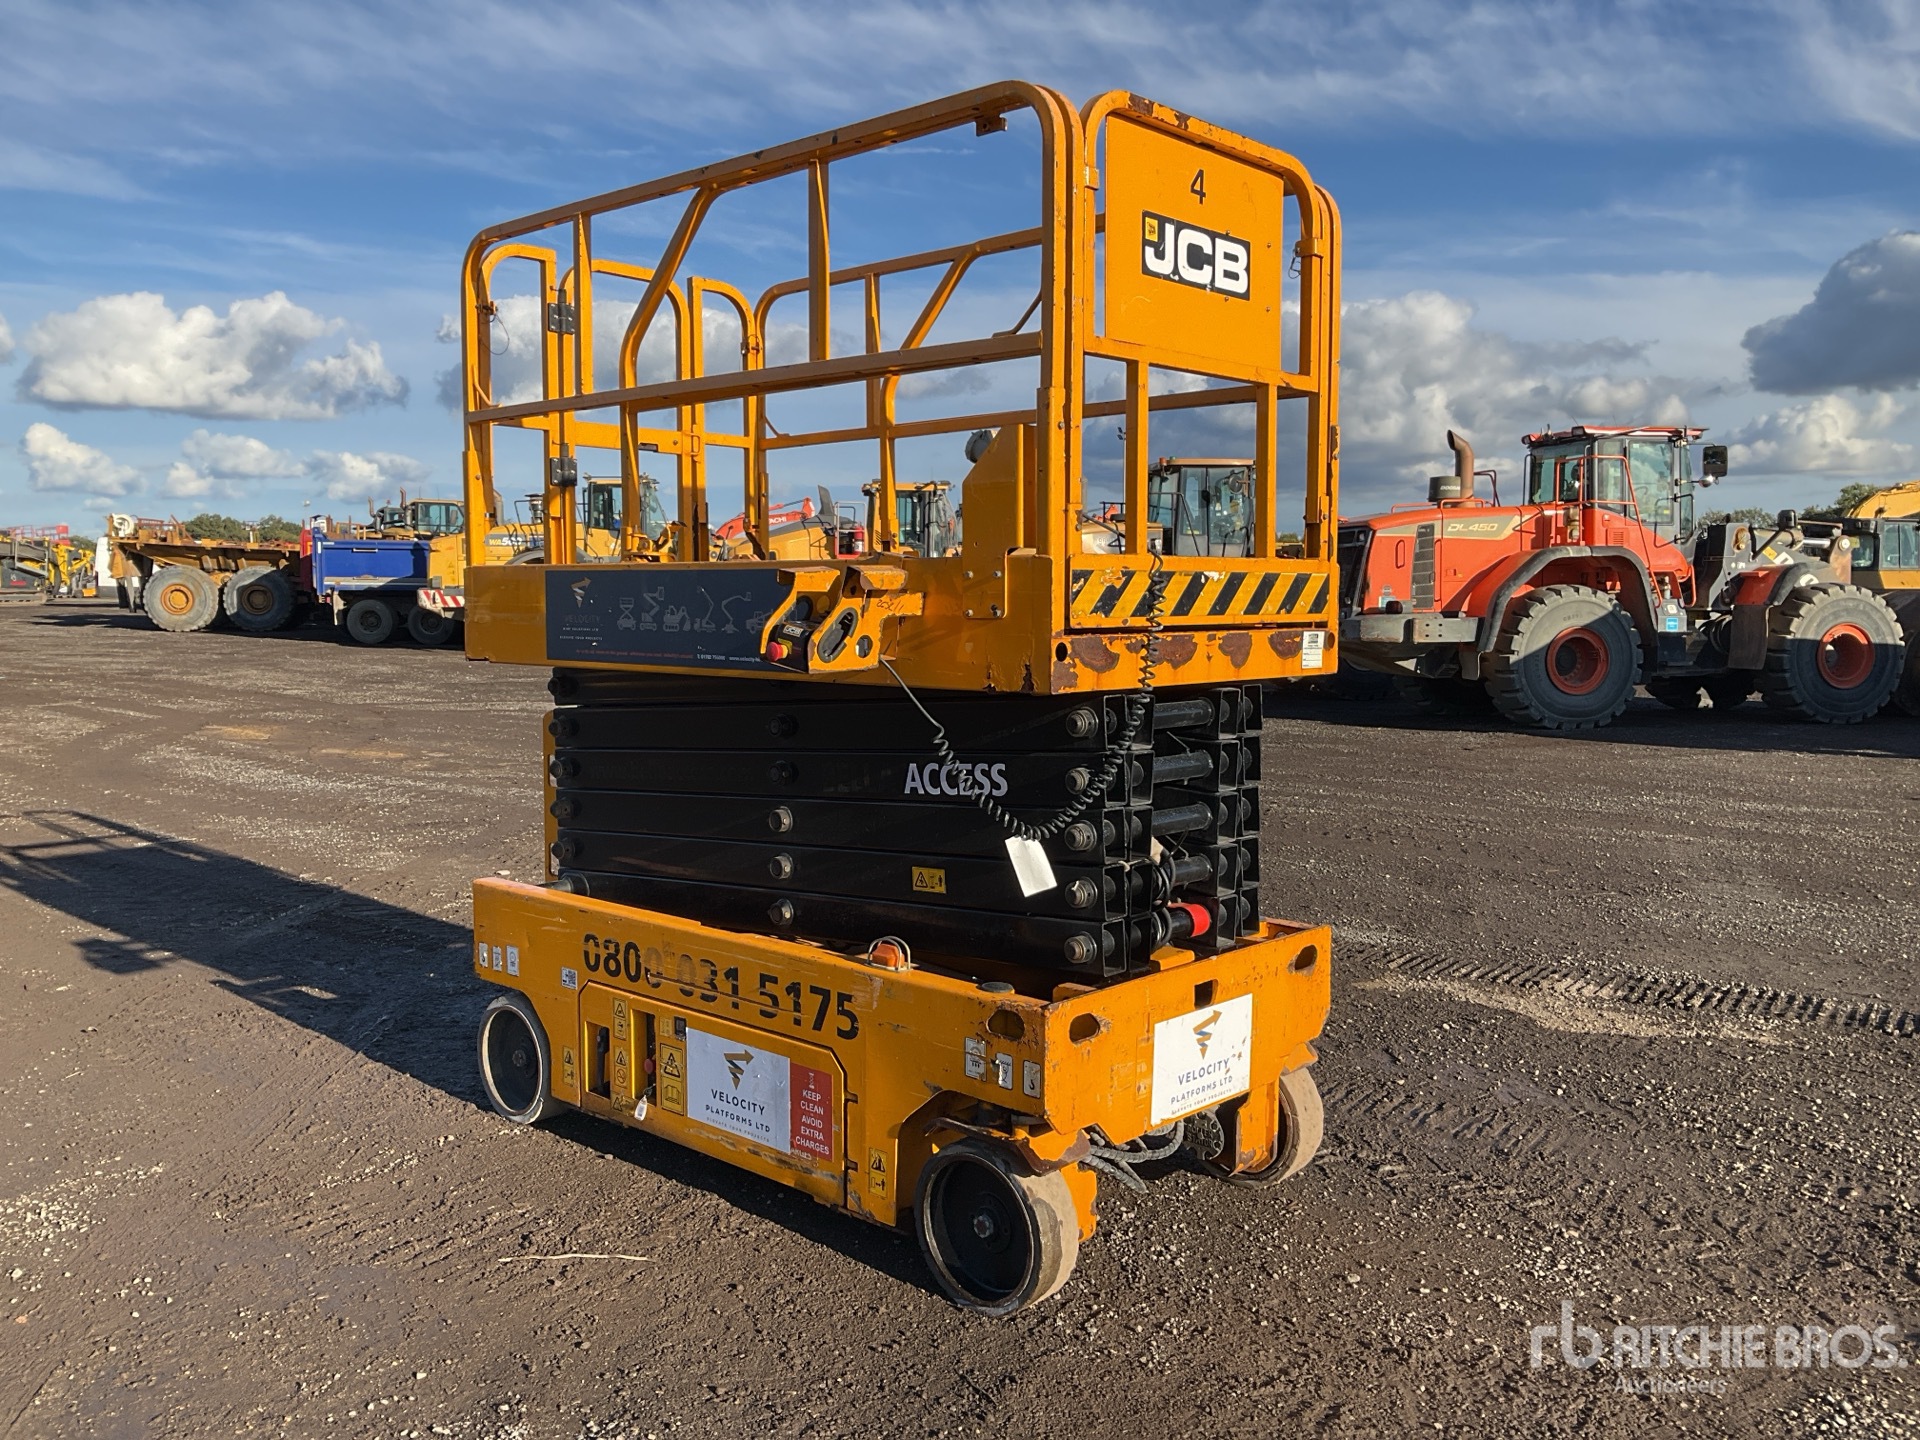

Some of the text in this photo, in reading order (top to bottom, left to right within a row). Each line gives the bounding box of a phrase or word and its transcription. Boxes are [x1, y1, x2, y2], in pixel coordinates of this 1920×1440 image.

[1190, 169, 1206, 205] 4
[1145, 222, 1249, 293] JCB
[1447, 523, 1498, 532] DL450
[904, 762, 1009, 797] ACCESS
[583, 933, 663, 989] 0800
[676, 953, 740, 1010] 031
[759, 972, 860, 1041] 5175
[1178, 1057, 1230, 1086] VELOCITY
[711, 1088, 766, 1117] VELOCITY
[802, 1089, 822, 1102] KEEP
[1170, 1075, 1233, 1106] PLATFORMS LTD
[705, 1104, 771, 1134] PLATFORMS LTD
[800, 1100, 824, 1116] CLEAN
[801, 1115, 823, 1129] AVOID
[795, 1135, 830, 1155] CHARGES
[800, 1126, 824, 1142] EXTRA
